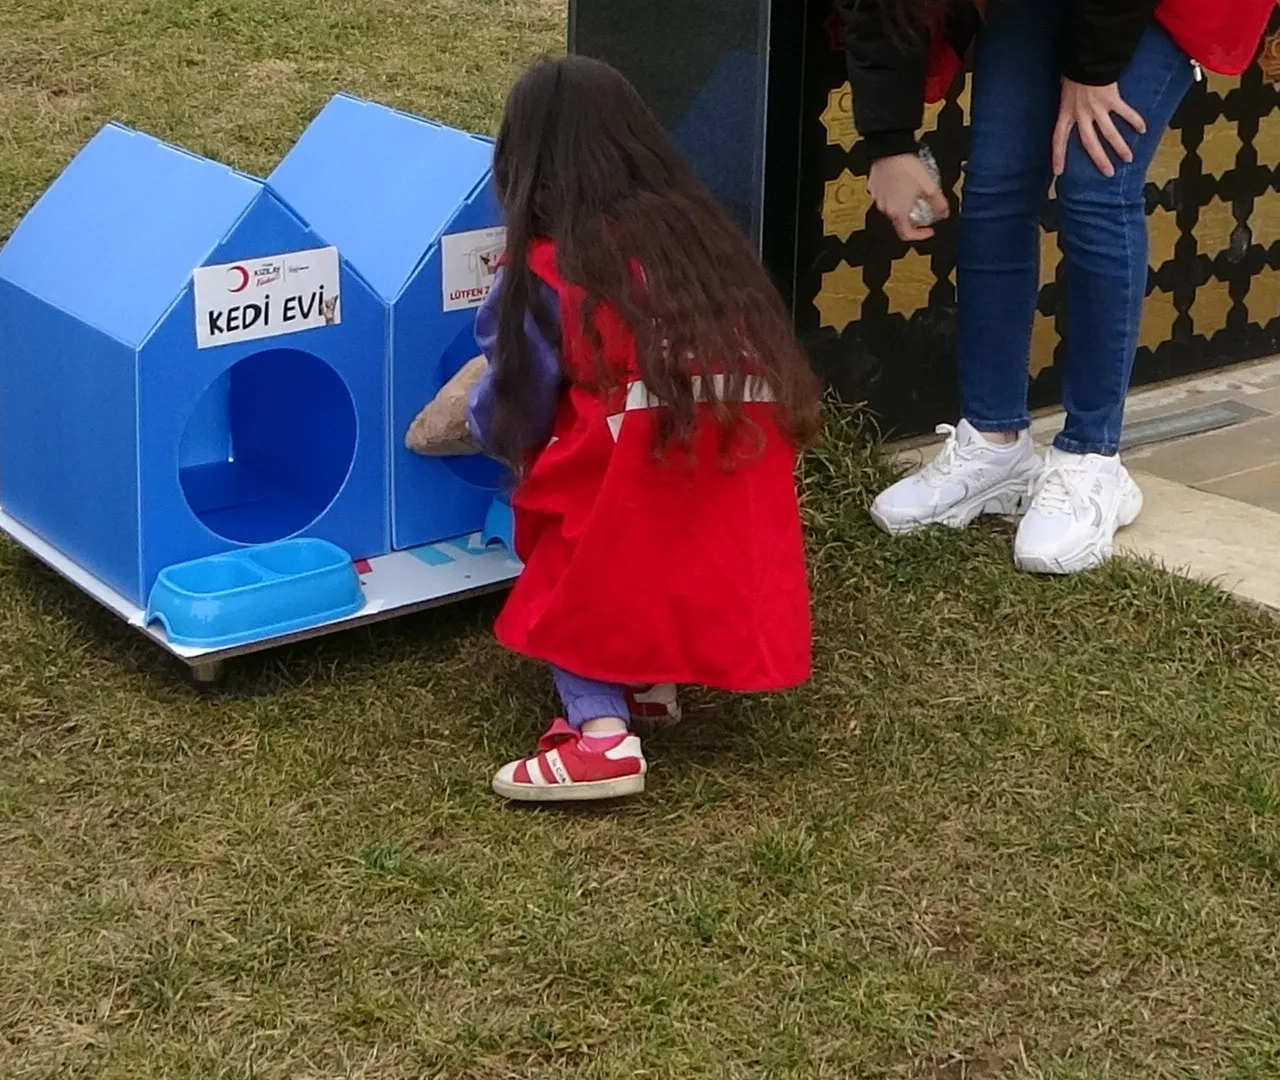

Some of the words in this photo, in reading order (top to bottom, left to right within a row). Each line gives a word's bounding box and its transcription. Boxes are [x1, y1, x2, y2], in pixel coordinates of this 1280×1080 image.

[208, 293, 270, 336] KEDİ
[282, 284, 325, 323] EVİ
[449, 287, 483, 301] LÜTFEN
